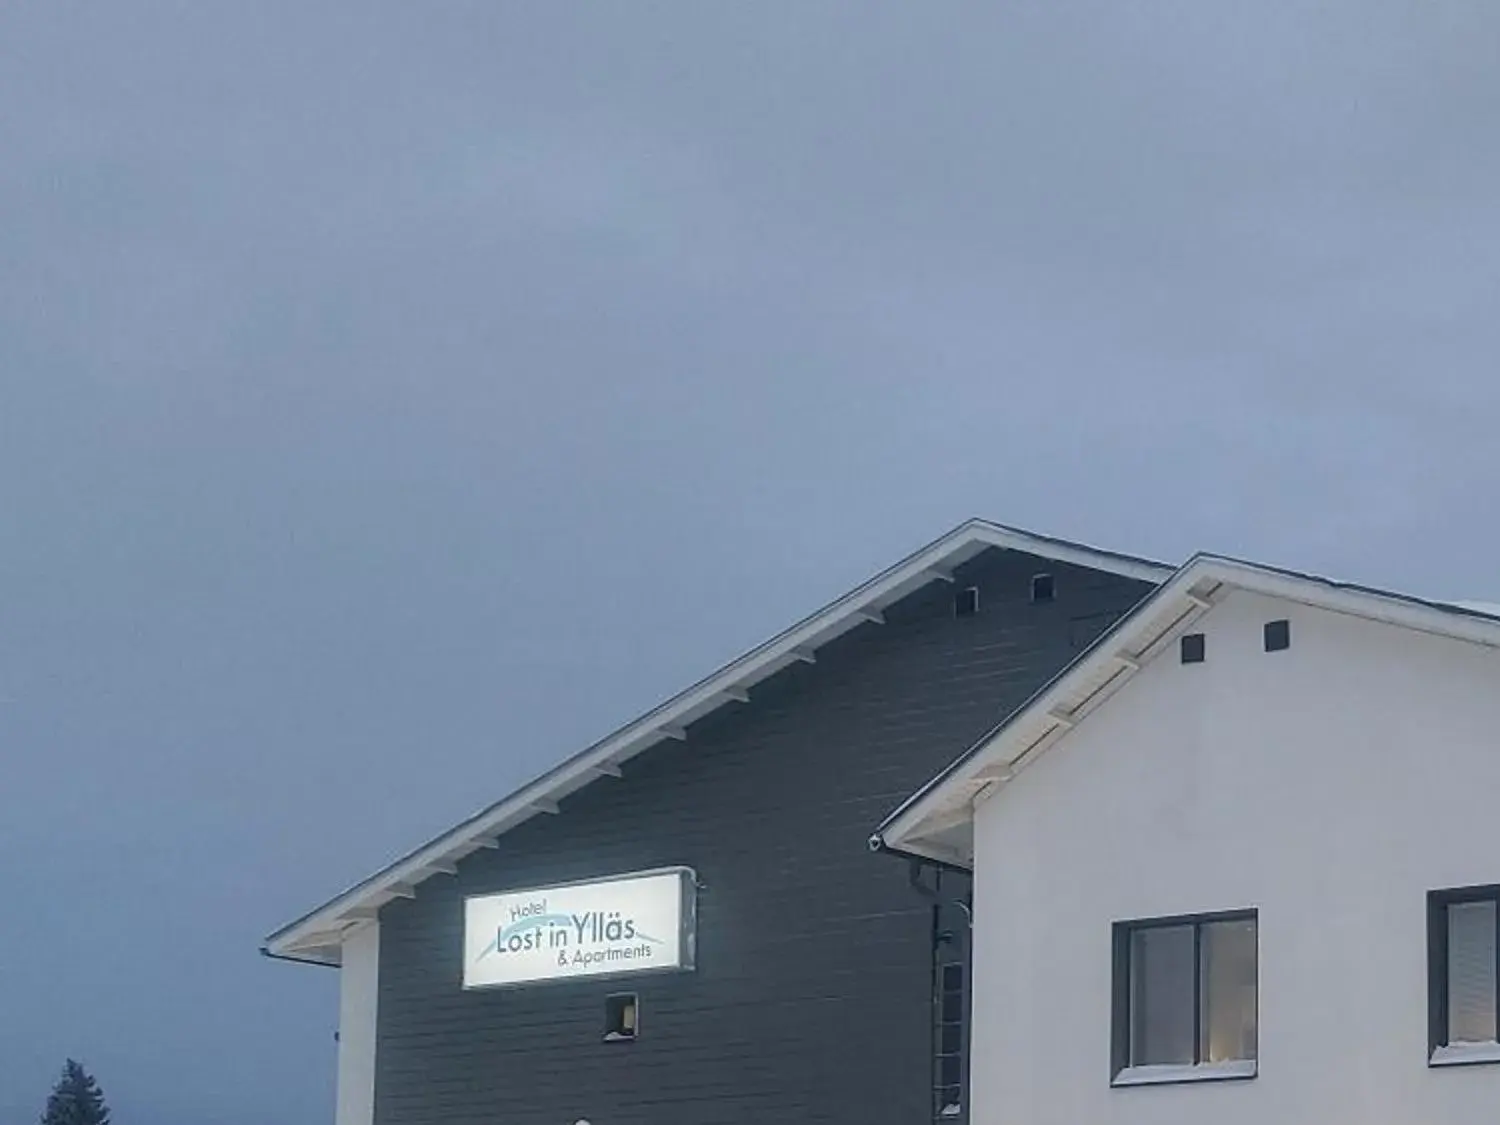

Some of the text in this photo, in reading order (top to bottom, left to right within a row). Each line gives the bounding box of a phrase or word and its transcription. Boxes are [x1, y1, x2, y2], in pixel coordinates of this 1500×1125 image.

[509, 899, 548, 921] Hotel
[496, 910, 636, 953] Lost in Ylläs
[557, 944, 653, 968] & Apartments
